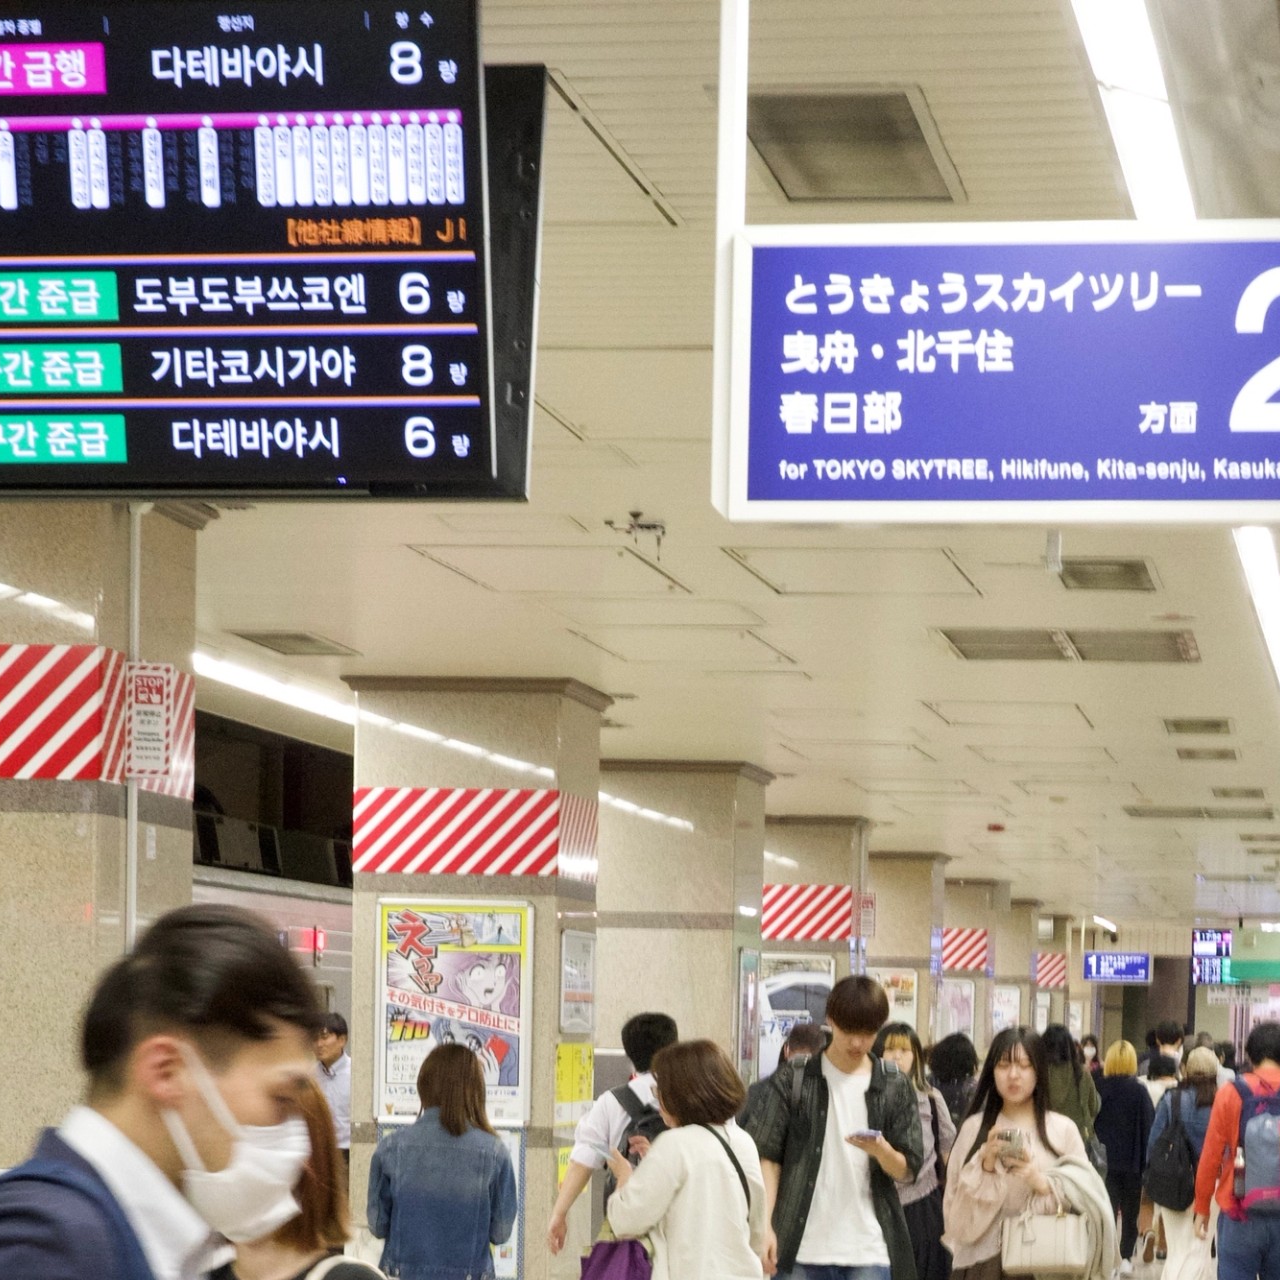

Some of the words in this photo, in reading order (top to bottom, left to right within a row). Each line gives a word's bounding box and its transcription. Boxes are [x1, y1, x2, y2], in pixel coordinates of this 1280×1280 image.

[22, 49, 87, 89] 급행
[151, 43, 324, 88] 다테바야시
[390, 41, 423, 85] 8
[37, 278, 101, 316] 준급
[133, 273, 368, 315] 도부도부쓰코엔
[399, 272, 430, 315] 6
[447, 289, 466, 314] 량
[785, 271, 1202, 314] とうきょうスカイツリー
[41, 349, 105, 387] 준급
[151, 345, 356, 388] 기타코시가야
[402, 344, 434, 387] 8
[450, 361, 468, 386] 량
[780, 329, 1015, 374] 曳舟・北千住
[778, 391, 903, 435] 春日部
[1138, 401, 1198, 435] 方面
[46, 421, 109, 458] 준급
[171, 417, 340, 460] 다테바야시
[404, 416, 436, 459] 6
[452, 433, 470, 458] 량
[778, 458, 808, 481] for
[813, 458, 886, 481] TOKYO
[891, 458, 995, 484] SKYTREE,
[1000, 458, 1089, 484] Hikifune,
[1096, 458, 1206, 484] Kita-senju,
[135, 677, 163, 688] STOP
[387, 990, 521, 1033] その気付きをテロ防止に!
